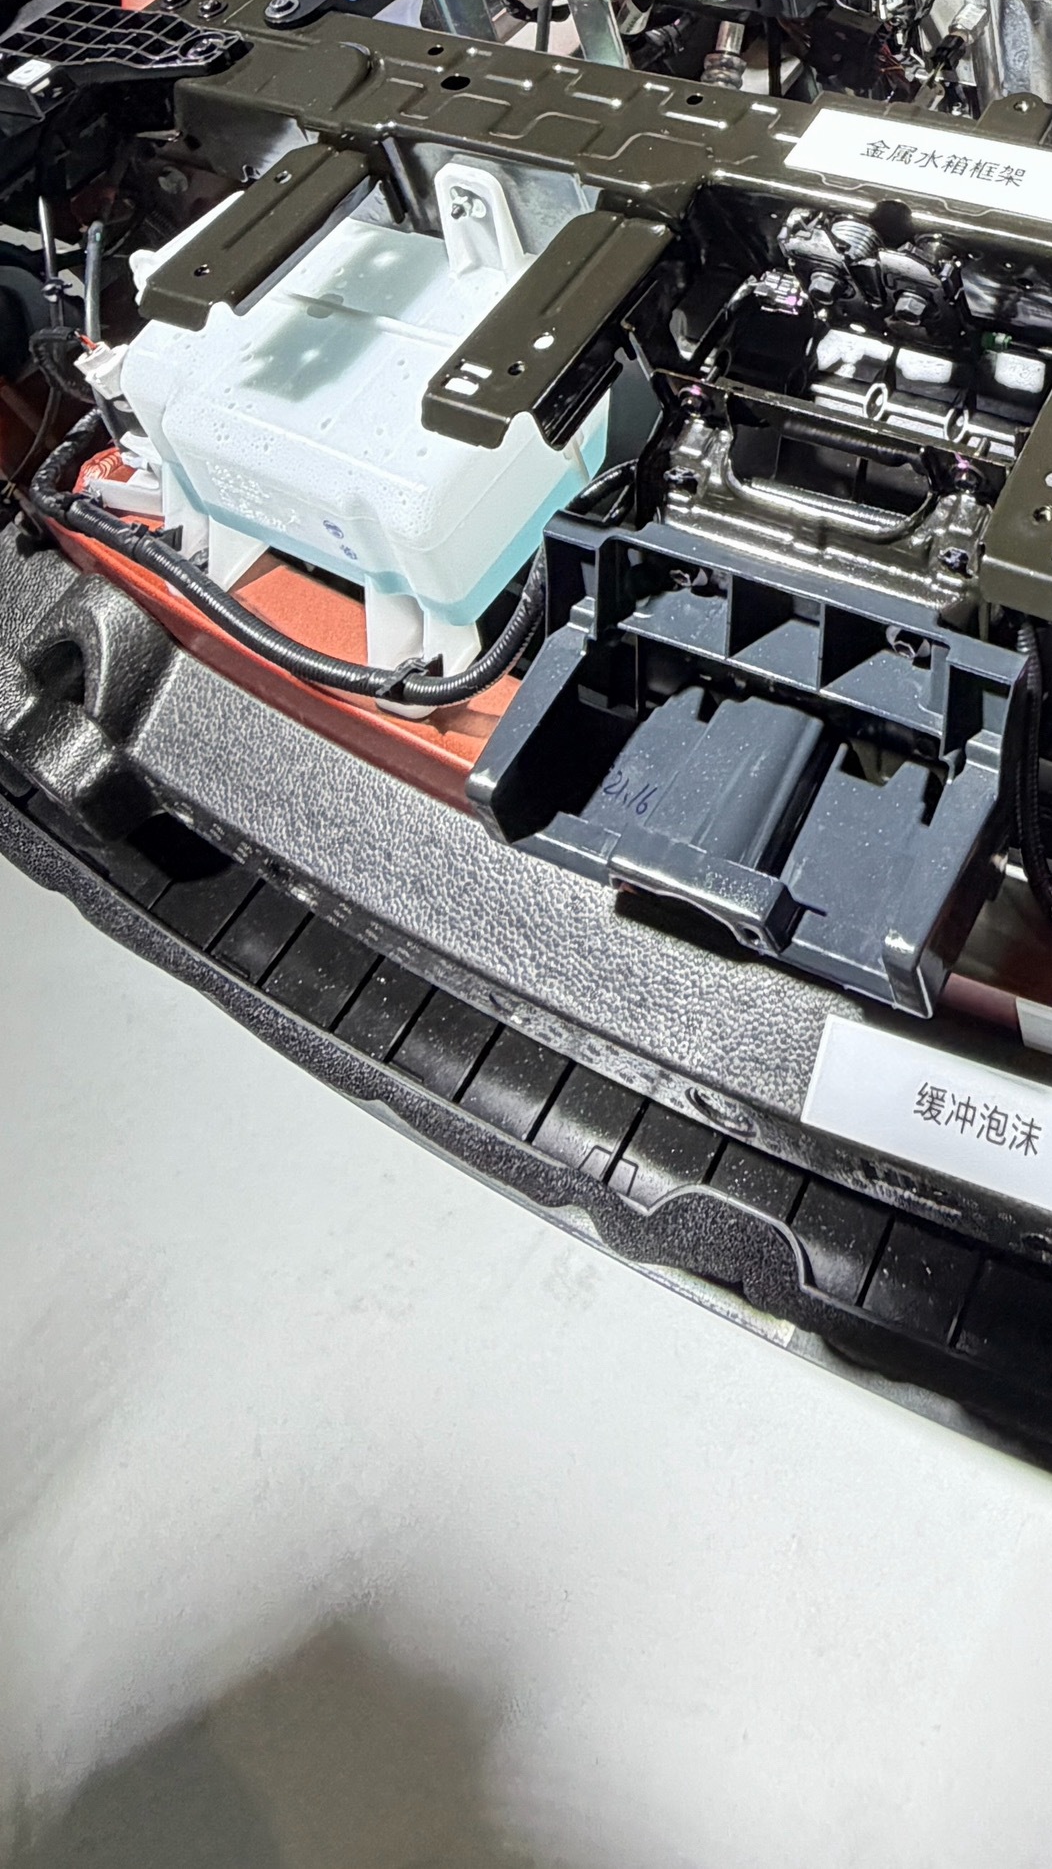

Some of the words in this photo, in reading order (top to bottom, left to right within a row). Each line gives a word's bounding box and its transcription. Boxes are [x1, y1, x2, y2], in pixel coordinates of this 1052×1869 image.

[859, 139, 1027, 187] 金属水箱框架
[913, 1081, 1043, 1157] 缓冲泡沫
